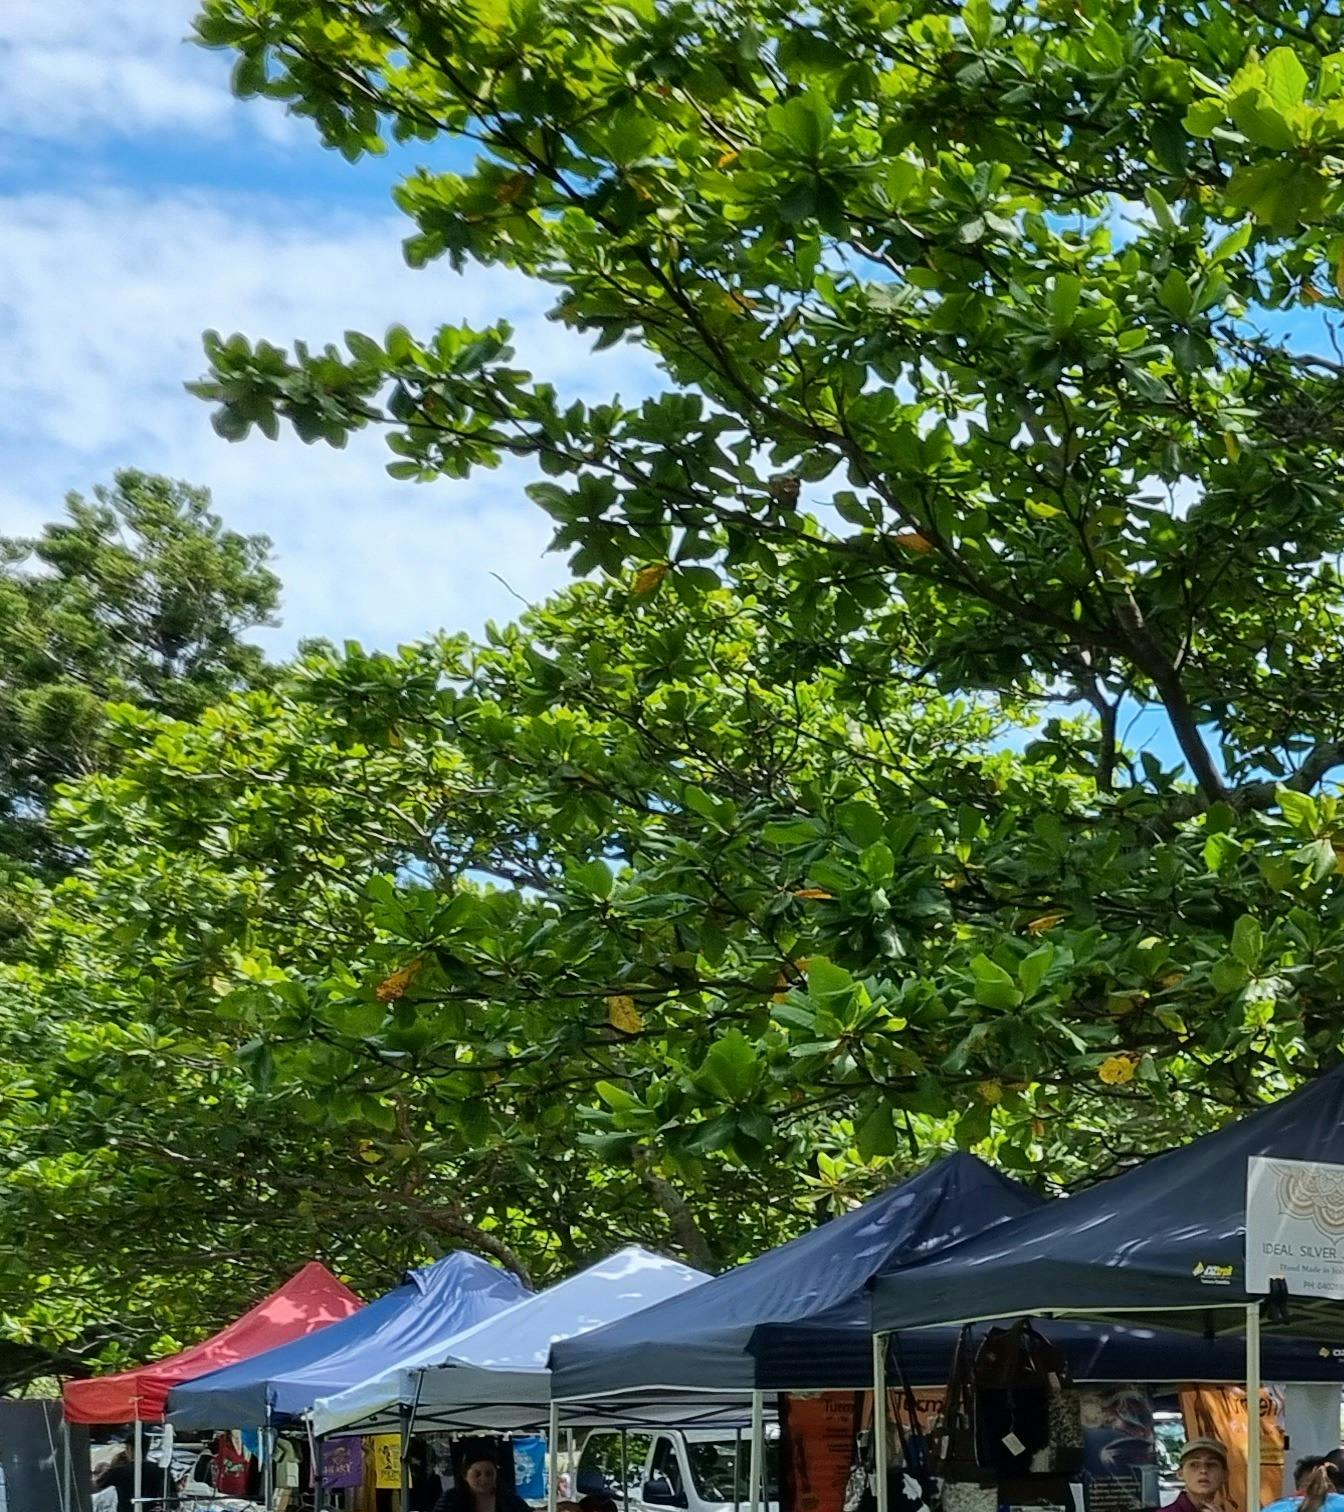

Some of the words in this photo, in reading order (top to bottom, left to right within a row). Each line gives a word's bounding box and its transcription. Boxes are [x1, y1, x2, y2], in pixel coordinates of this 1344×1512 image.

[1262, 1242, 1294, 1257] IDEAL
[1300, 1245, 1337, 1260] SILVER
[1301, 1264, 1322, 1274] Made
